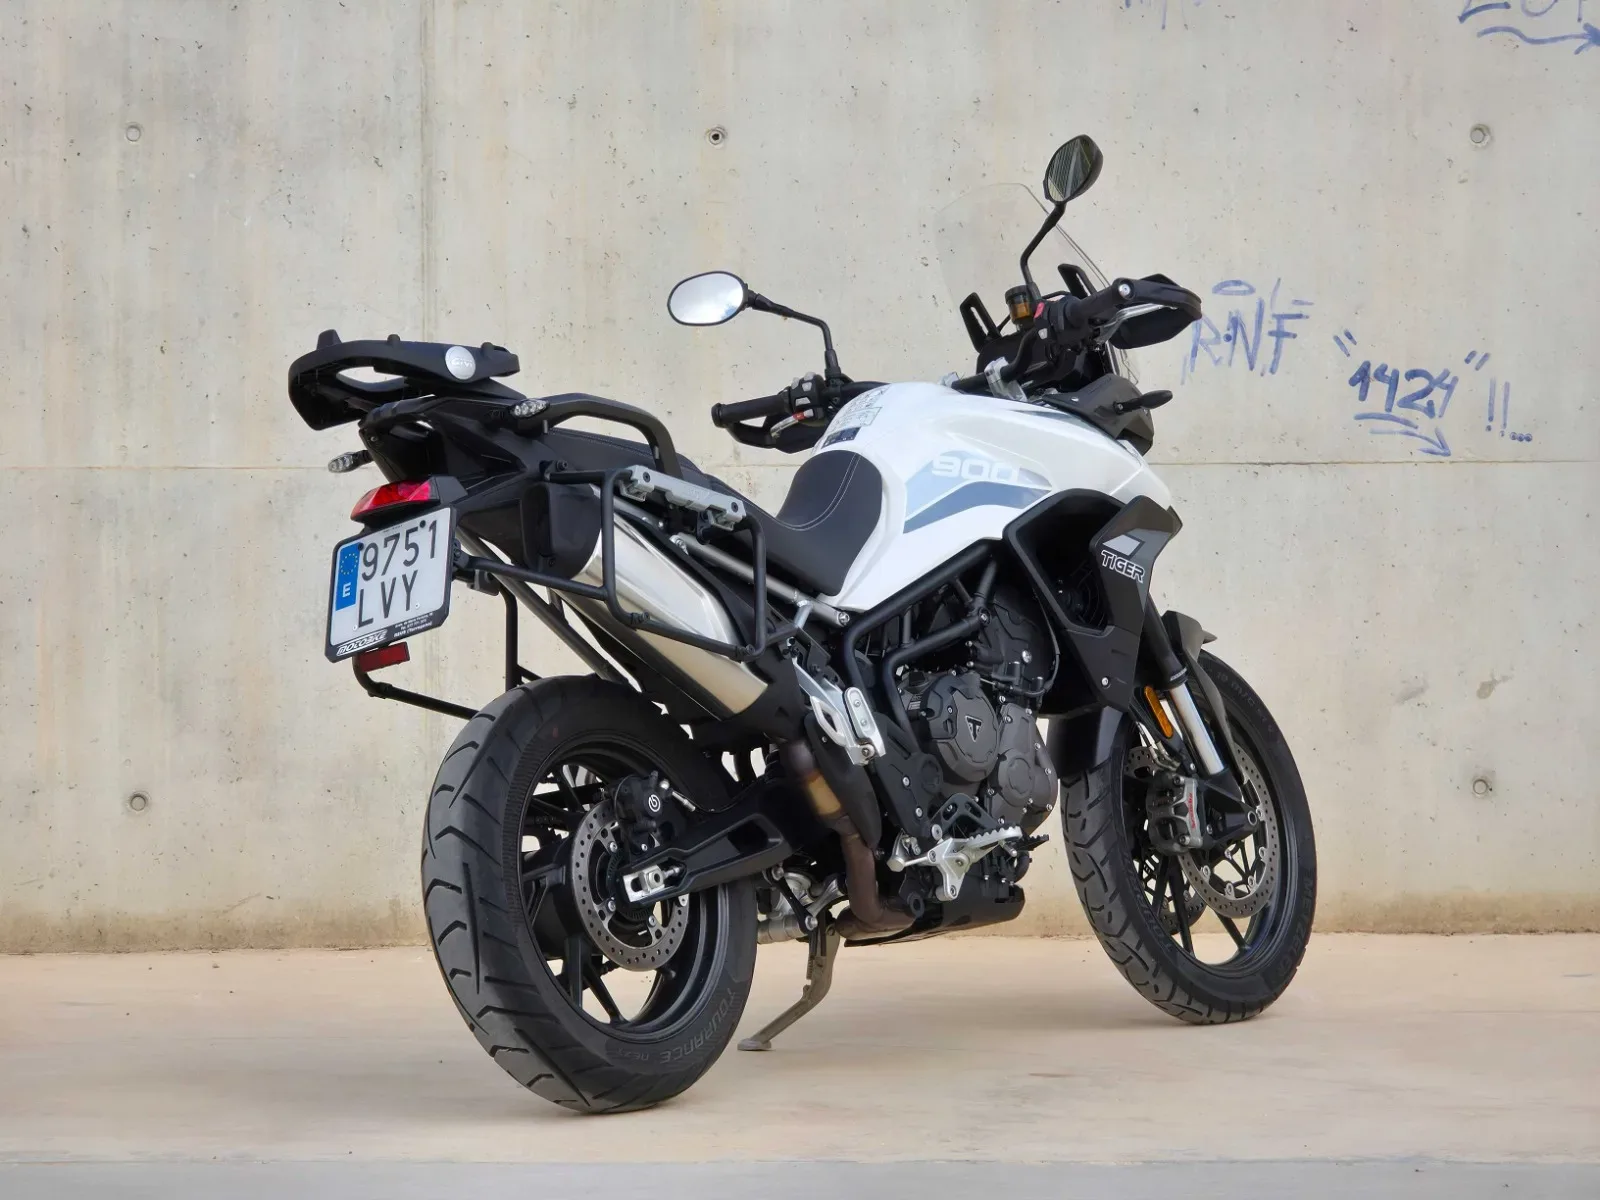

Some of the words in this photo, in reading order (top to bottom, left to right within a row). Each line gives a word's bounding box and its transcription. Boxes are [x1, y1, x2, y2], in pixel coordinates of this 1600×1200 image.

[931, 456, 1019, 483] 900
[361, 520, 438, 581] 9751
[1101, 549, 1145, 583] TIGER
[342, 582, 352, 598] E
[358, 570, 418, 628] LVY
